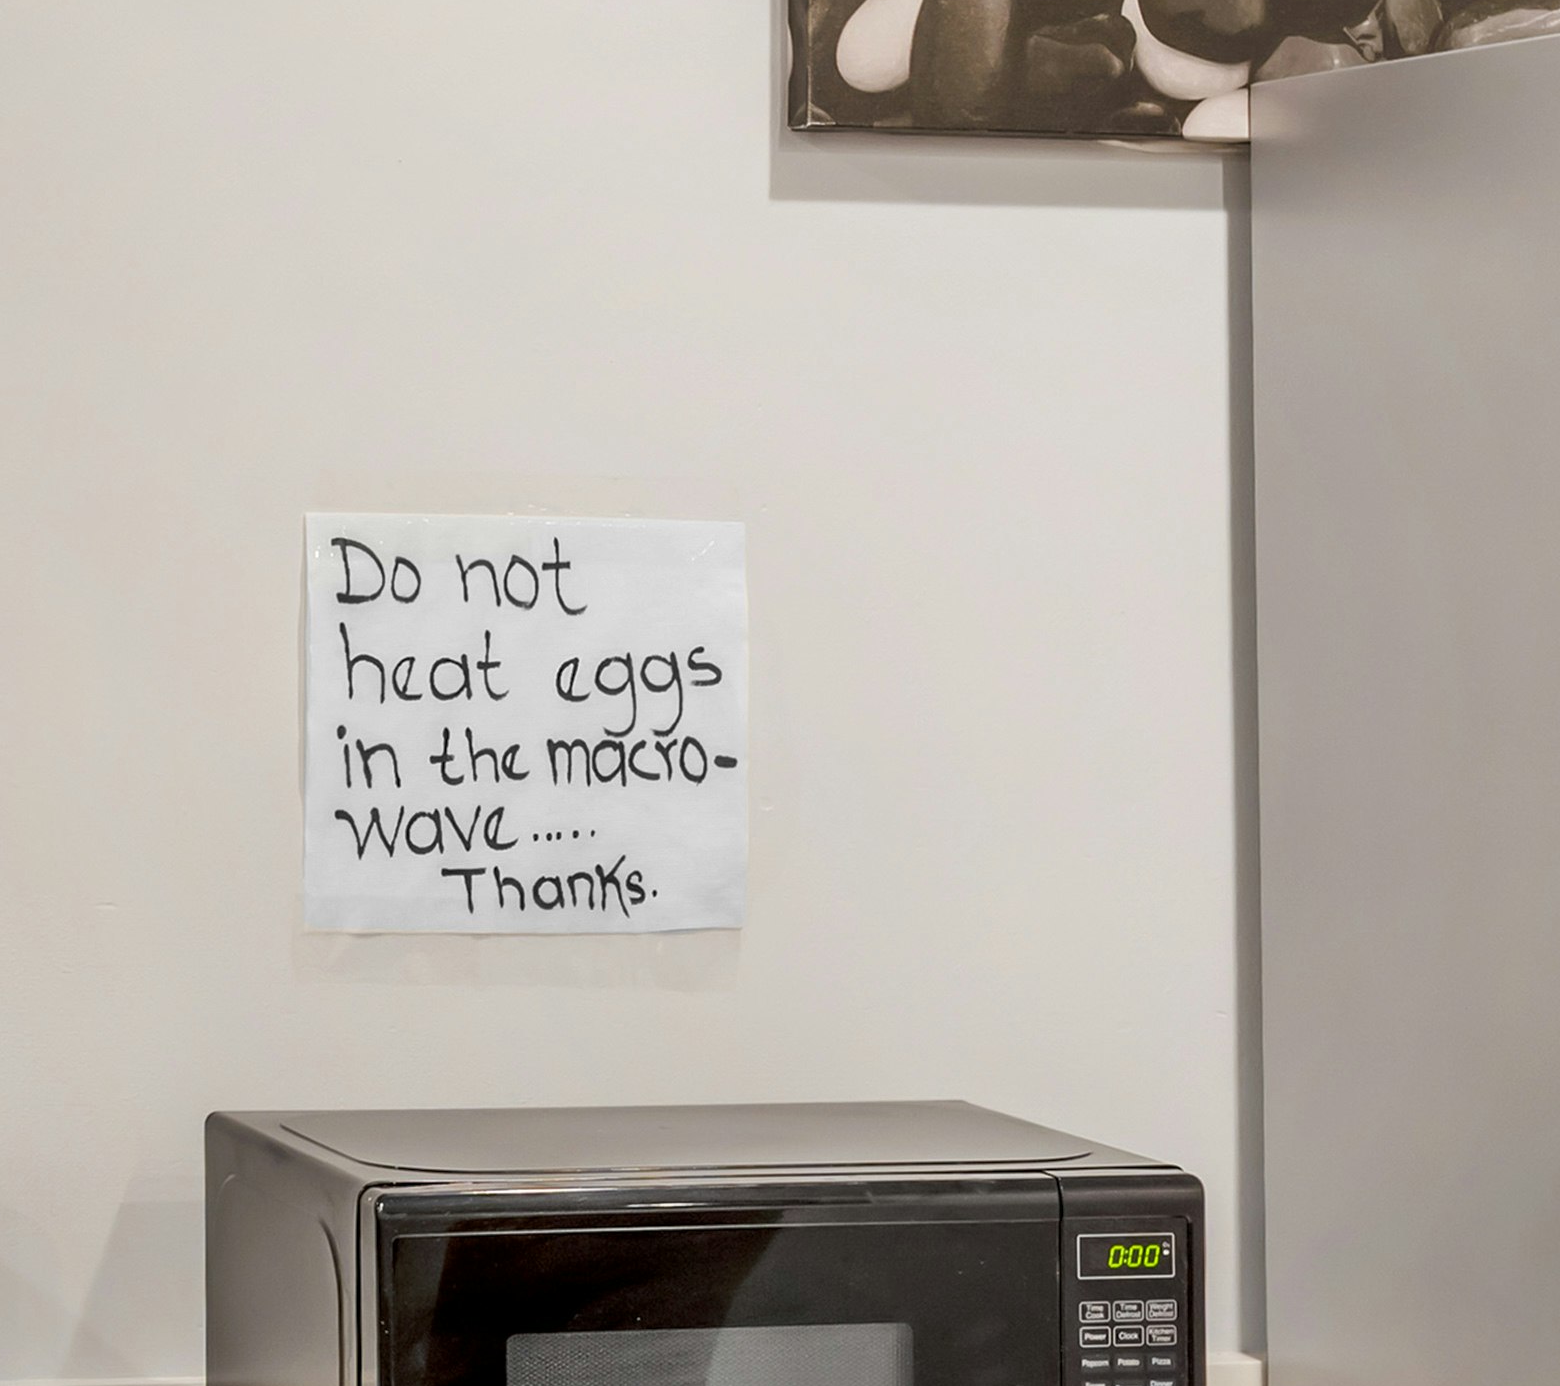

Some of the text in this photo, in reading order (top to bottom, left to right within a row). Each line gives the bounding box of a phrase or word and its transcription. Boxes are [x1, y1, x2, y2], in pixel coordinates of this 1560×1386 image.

[331, 537, 588, 616] Do not
[339, 622, 723, 738] heat eggs
[336, 725, 738, 788] in the macro-
[1108, 1244, 1160, 1269] 0:00
[1117, 1331, 1139, 1340] Clock
